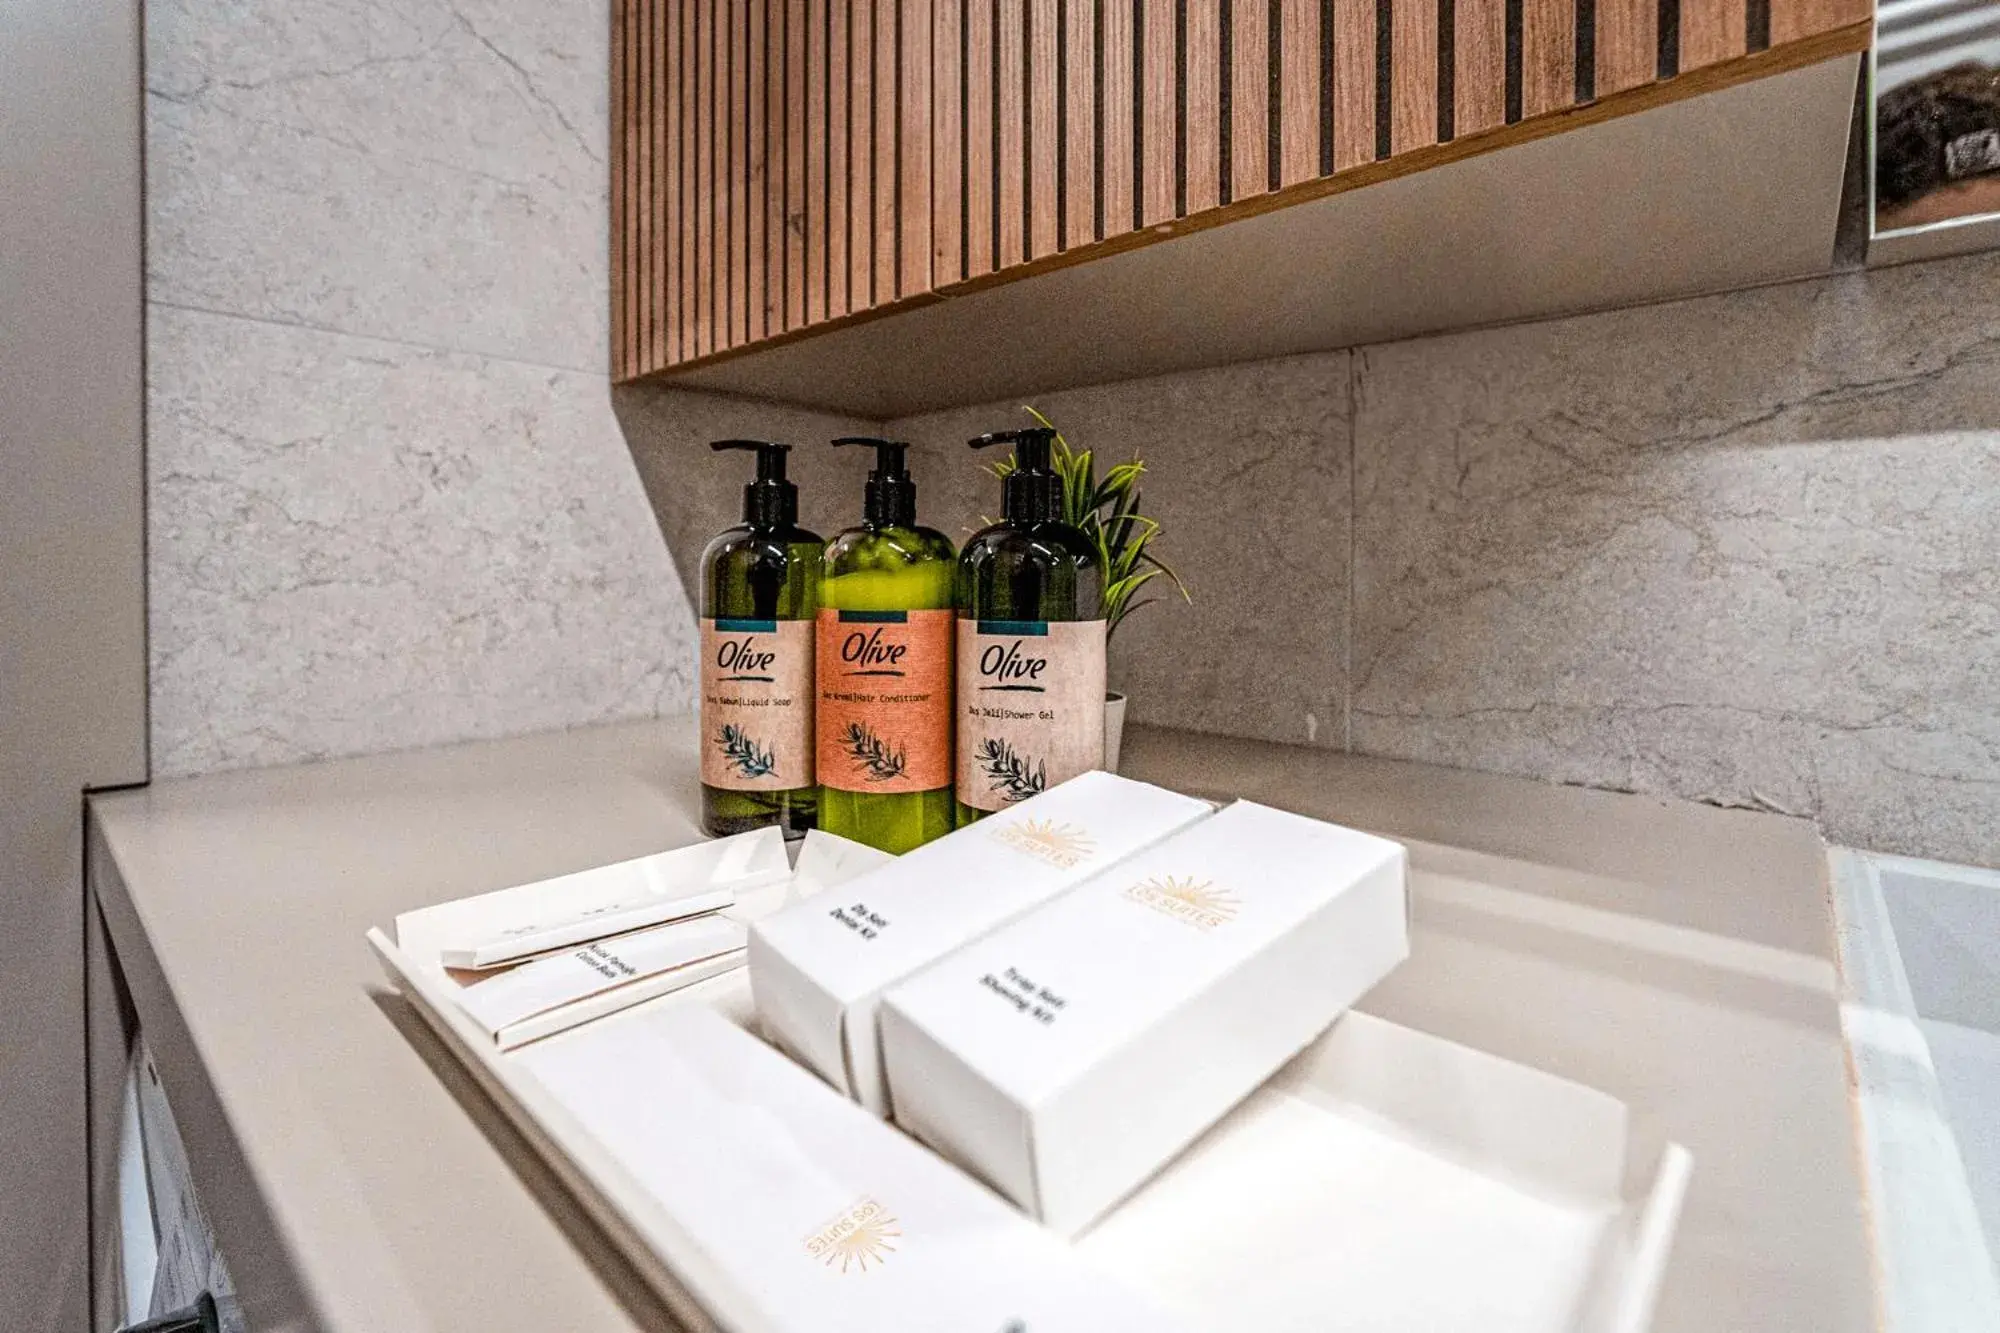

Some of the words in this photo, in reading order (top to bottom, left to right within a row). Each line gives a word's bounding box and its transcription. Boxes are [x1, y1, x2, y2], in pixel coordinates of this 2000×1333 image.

[717, 636, 776, 674] Olive
[841, 627, 907, 667] Olive
[980, 639, 1047, 682] Olive
[773, 697, 793, 708] Soap
[880, 694, 932, 704] Conditioner
[1038, 710, 1055, 720] Gel
